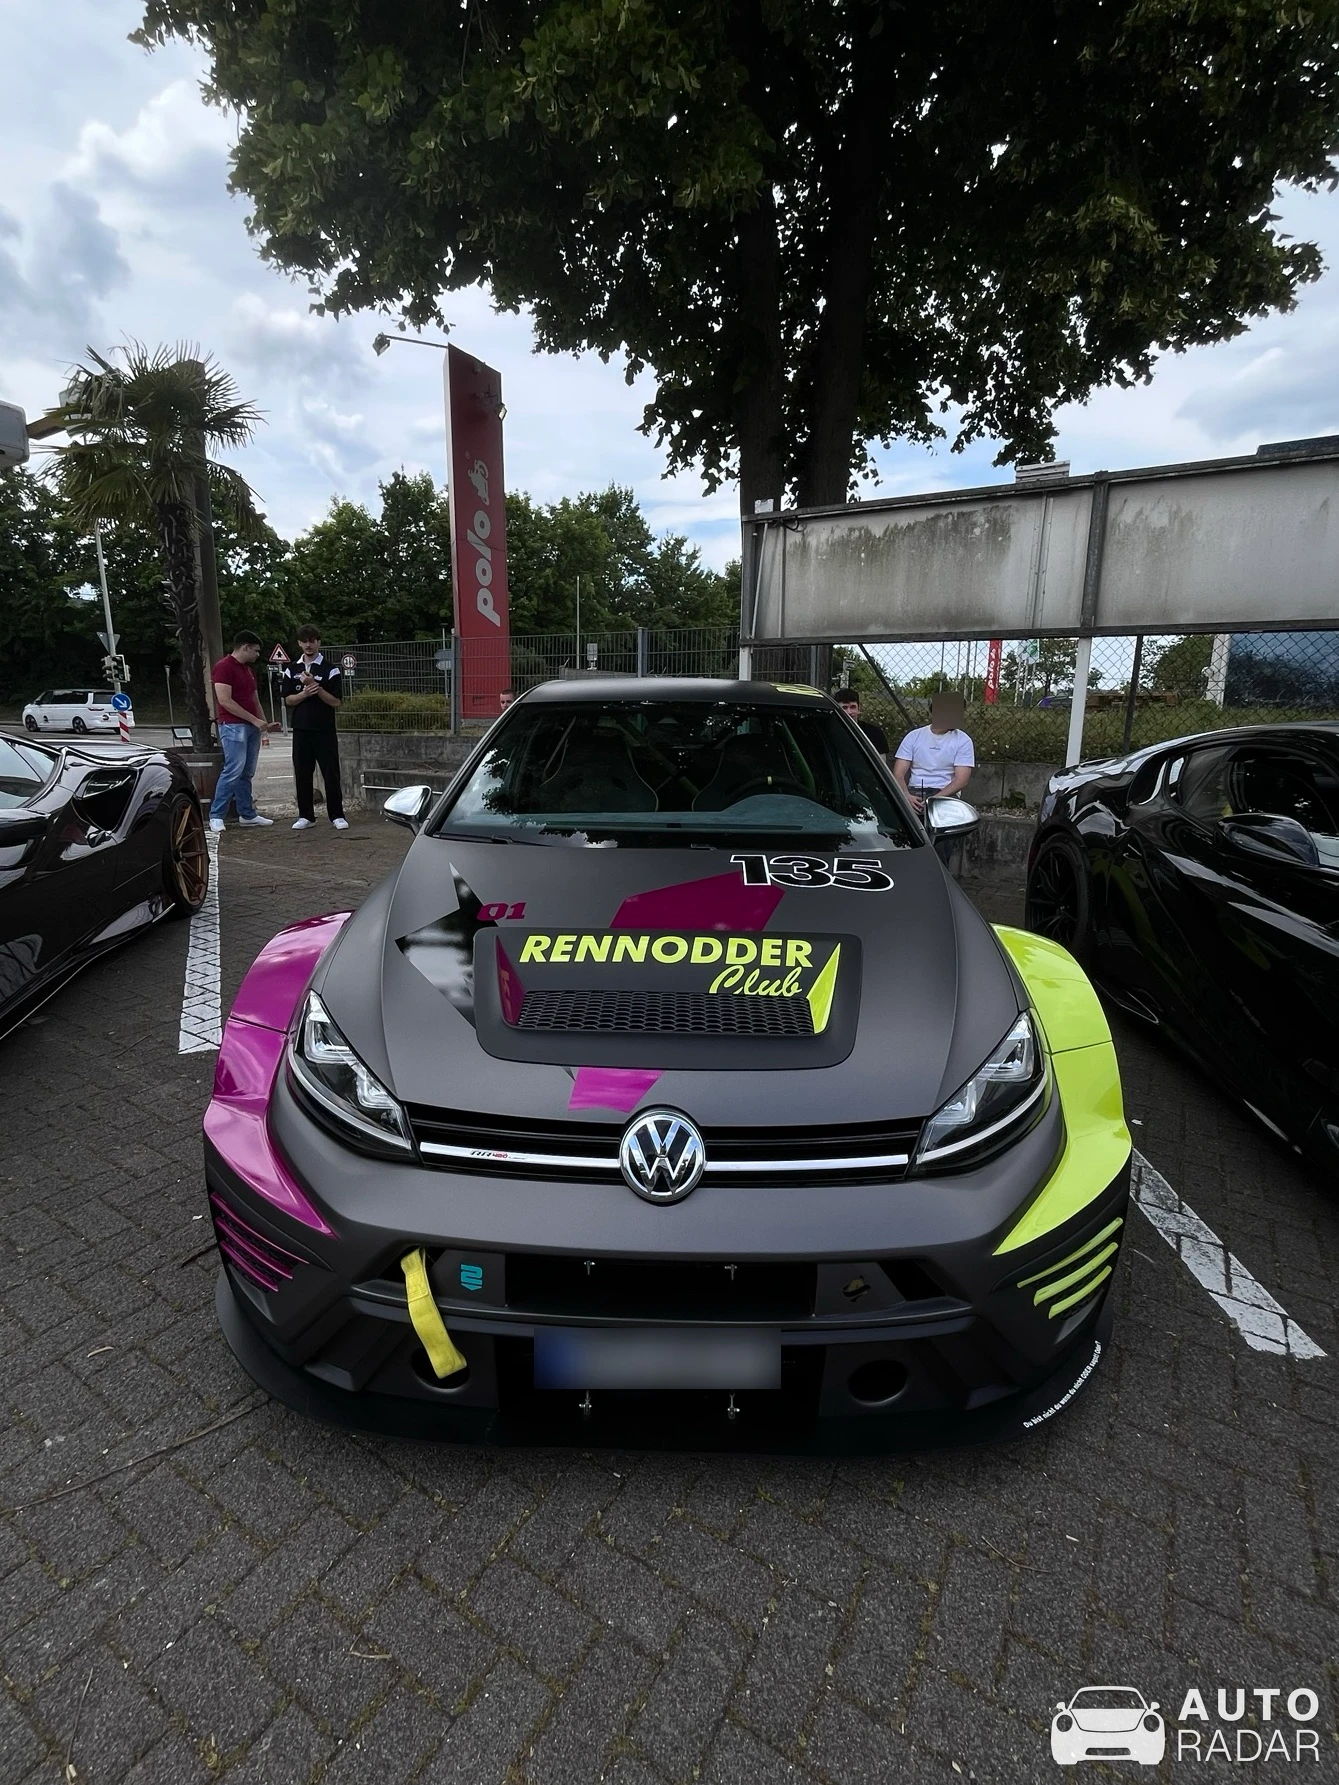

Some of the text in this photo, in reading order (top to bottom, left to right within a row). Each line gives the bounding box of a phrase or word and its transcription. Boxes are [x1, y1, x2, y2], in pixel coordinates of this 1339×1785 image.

[467, 510, 500, 627] polo
[730, 854, 895, 892] 135
[519, 935, 813, 968] RENNODDER
[709, 965, 803, 997] Club
[1031, 1415, 1044, 1424] bist
[1043, 1407, 1057, 1419] nicht
[1060, 1393, 1072, 1405] wenn
[1073, 1377, 1085, 1390] nicht
